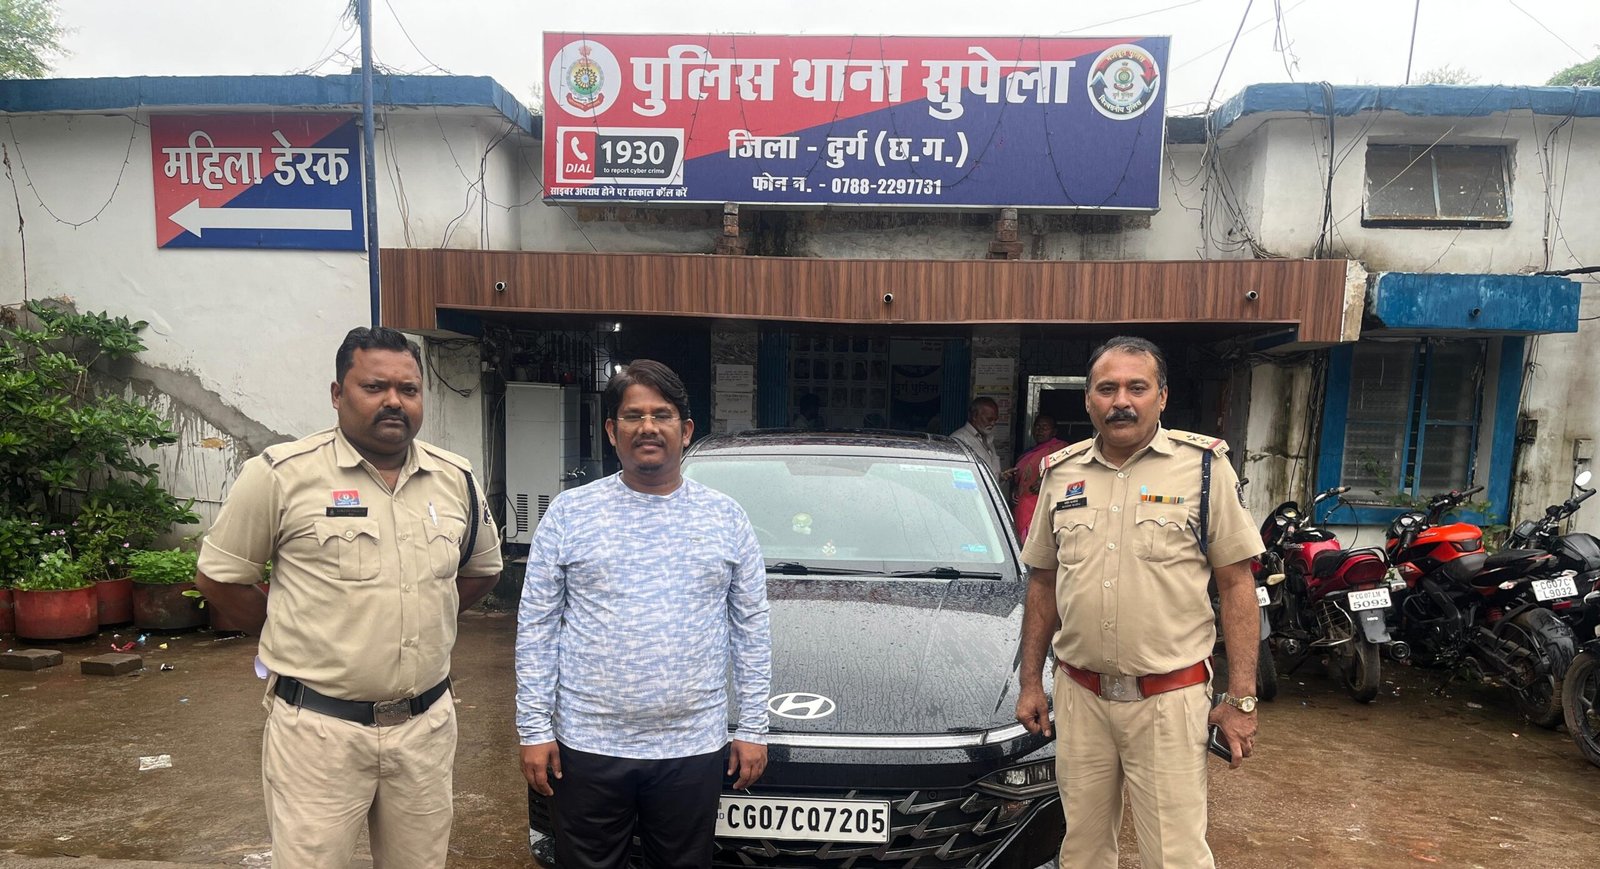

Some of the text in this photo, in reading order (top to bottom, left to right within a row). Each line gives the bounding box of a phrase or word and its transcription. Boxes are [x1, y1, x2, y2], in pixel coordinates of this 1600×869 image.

[630, 44, 1077, 120] पुलिस थाना सुपेला
[162, 130, 350, 190] महिला डेस्क
[601, 140, 665, 165] 1930
[728, 129, 800, 159] जिला
[826, 130, 868, 168] दुर्ग
[874, 130, 969, 168] (छ.ग.)
[565, 163, 592, 173] DIAL
[630, 167, 647, 175] cyber
[550, 185, 688, 197] साइबर अपराध होने पर तत्काल कॉल करें
[752, 172, 789, 191] फोन
[832, 178, 942, 195] 0788-2297731
[1353, 598, 1389, 609] 5093
[1543, 587, 1573, 599] L9032
[727, 804, 885, 834] CG07CQ7205
